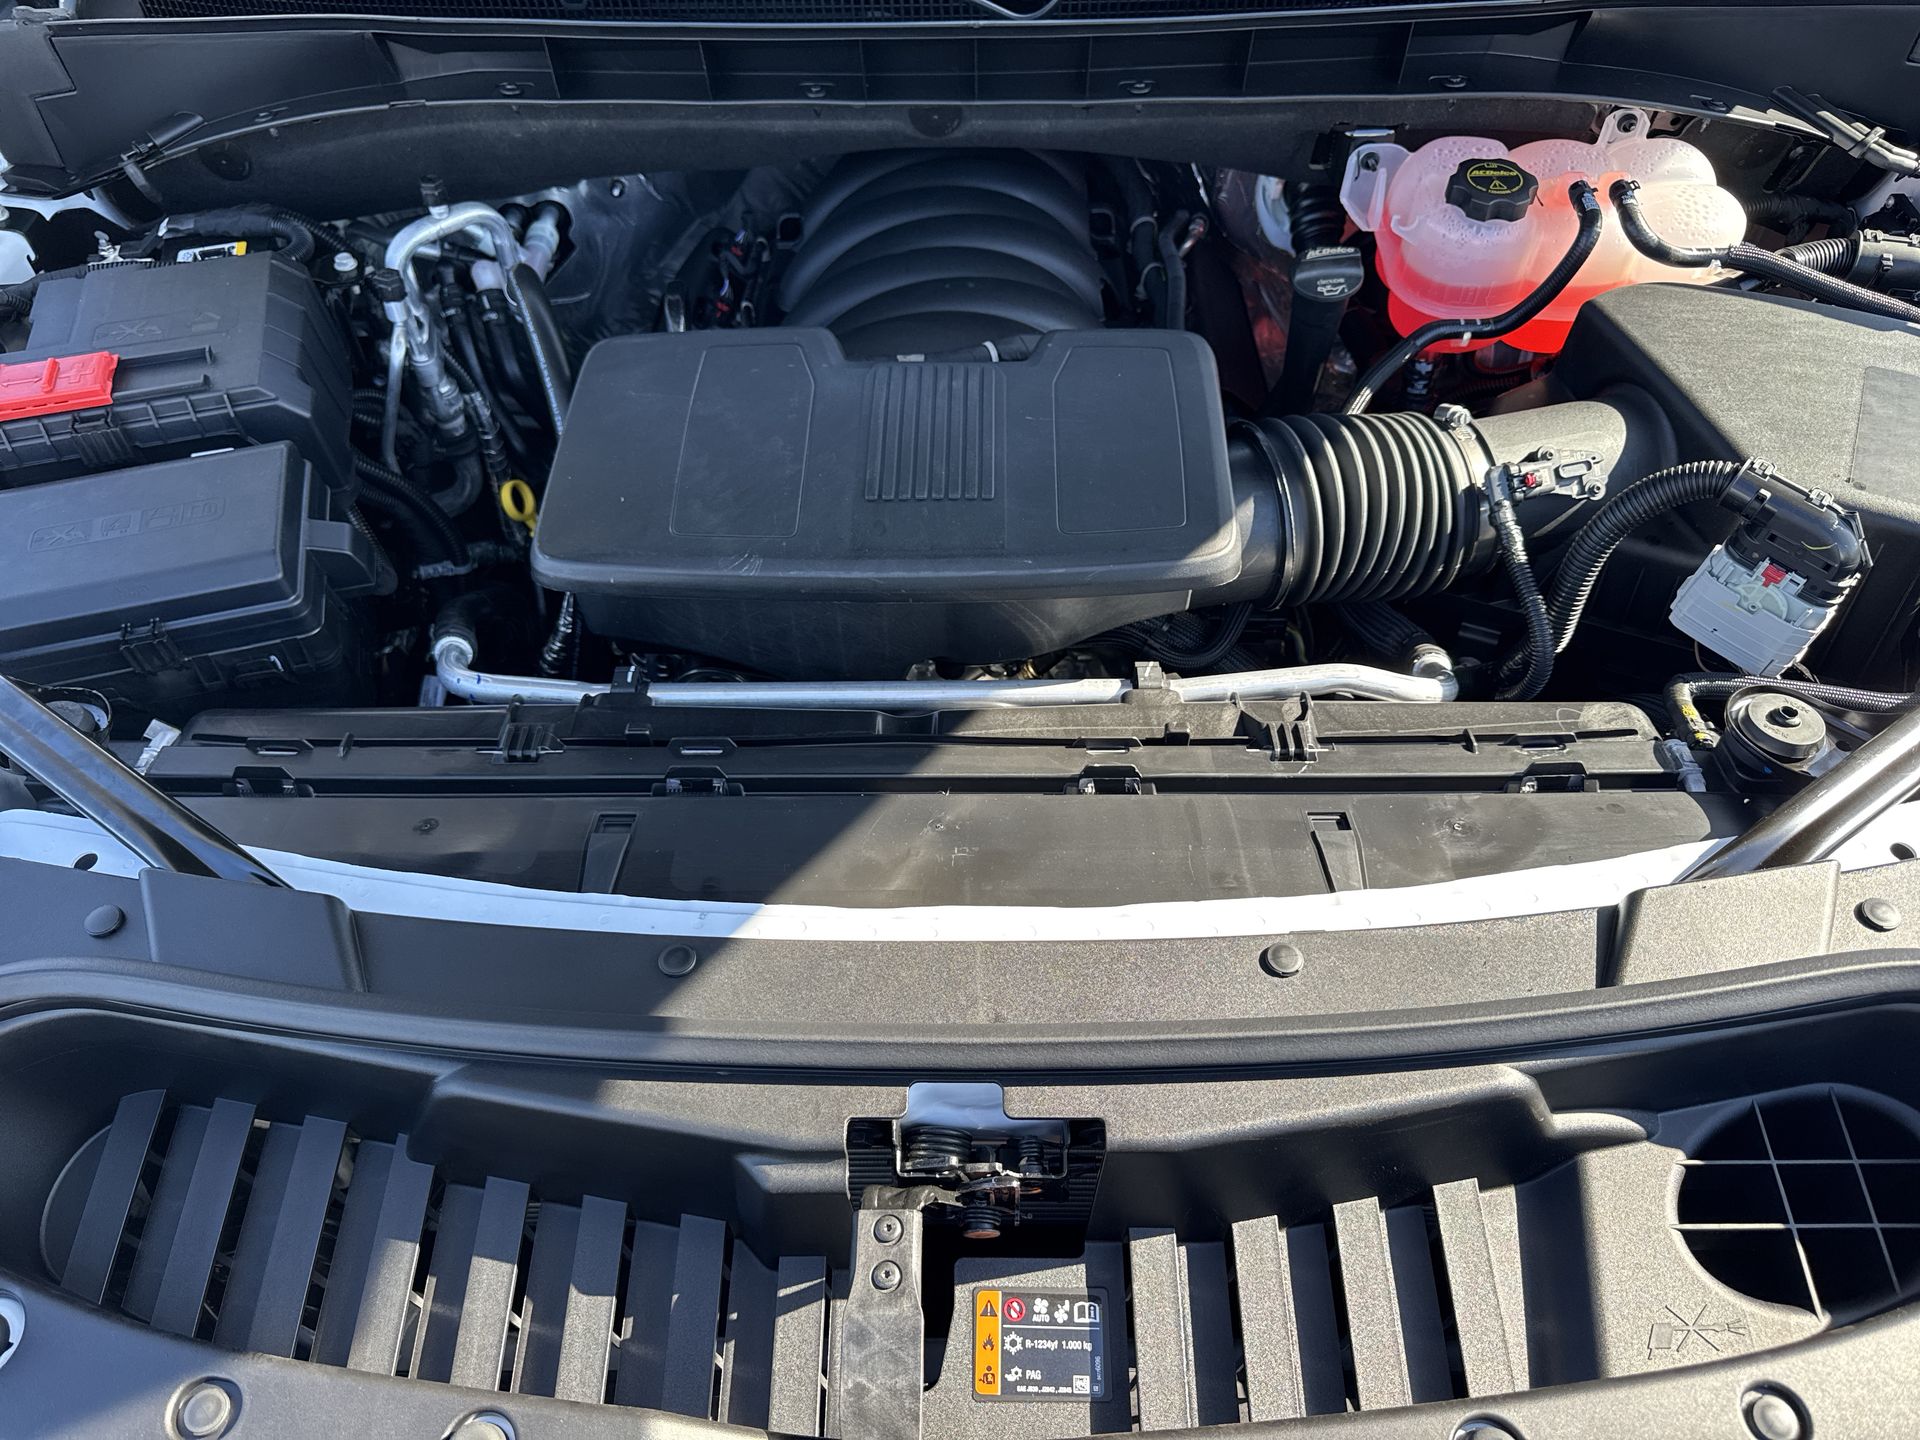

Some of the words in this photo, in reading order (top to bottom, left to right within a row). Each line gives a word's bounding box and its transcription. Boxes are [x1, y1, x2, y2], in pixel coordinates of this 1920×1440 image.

[1469, 169, 1517, 177] ACDelco
[1306, 247, 1355, 260] ACDelco
[1032, 1314, 1050, 1322] AUTO
[1025, 1339, 1058, 1352] R-1234yf
[1062, 1340, 1082, 1350] 1.000
[1083, 1340, 1092, 1352] kg
[1025, 1369, 1041, 1380] PAG
